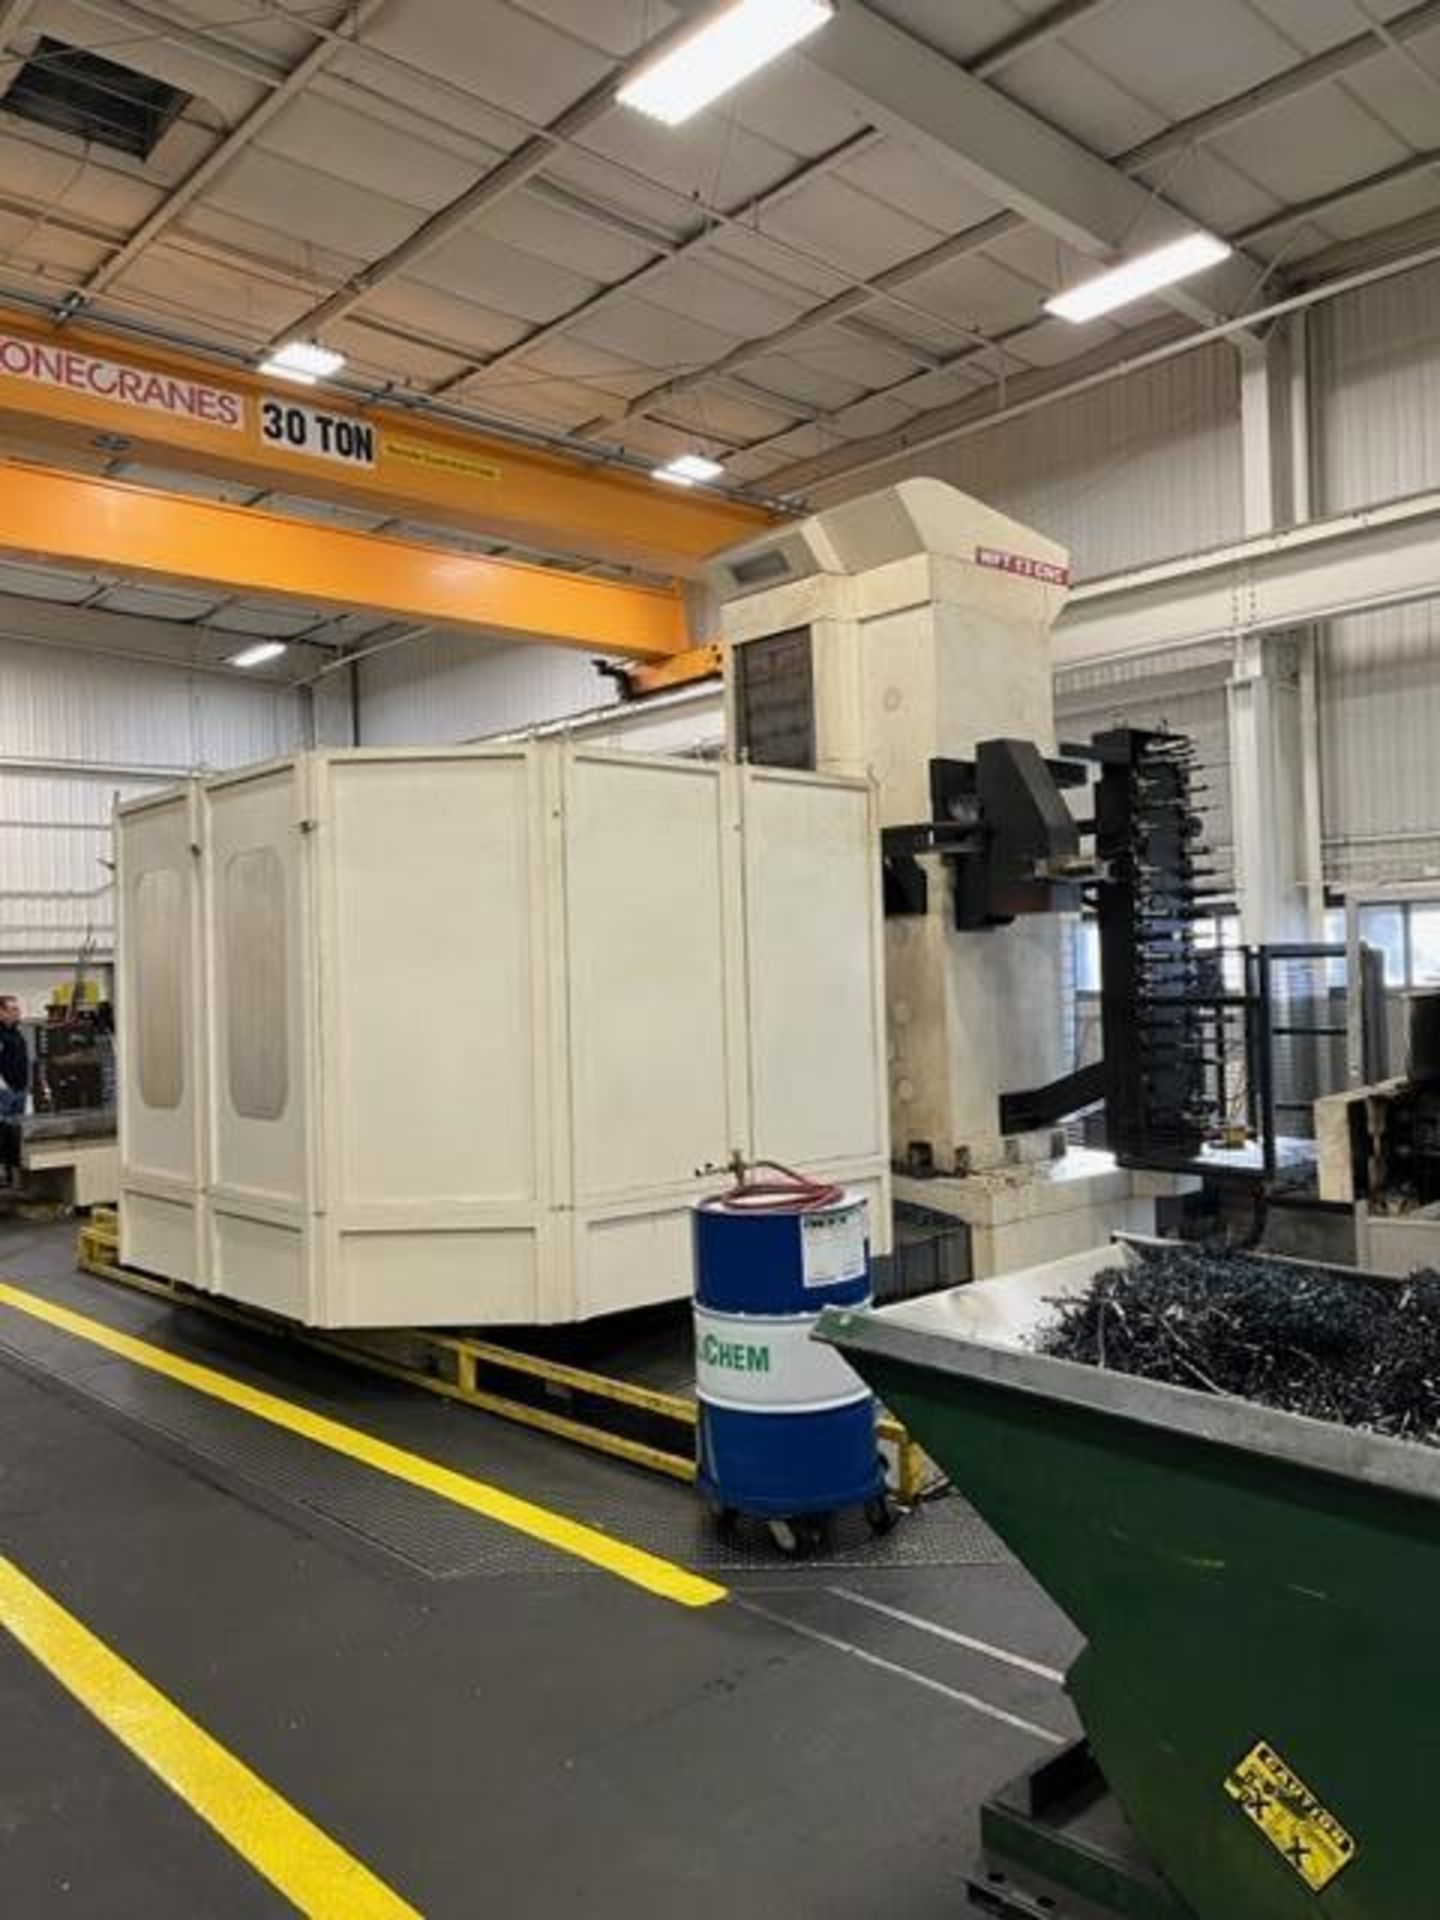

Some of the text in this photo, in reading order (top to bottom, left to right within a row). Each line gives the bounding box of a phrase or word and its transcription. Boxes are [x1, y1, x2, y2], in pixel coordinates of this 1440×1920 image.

[0, 341, 238, 424] ONECRANES
[263, 403, 306, 445] 30
[316, 417, 374, 462] TON
[700, 1333, 769, 1373] CHEM
